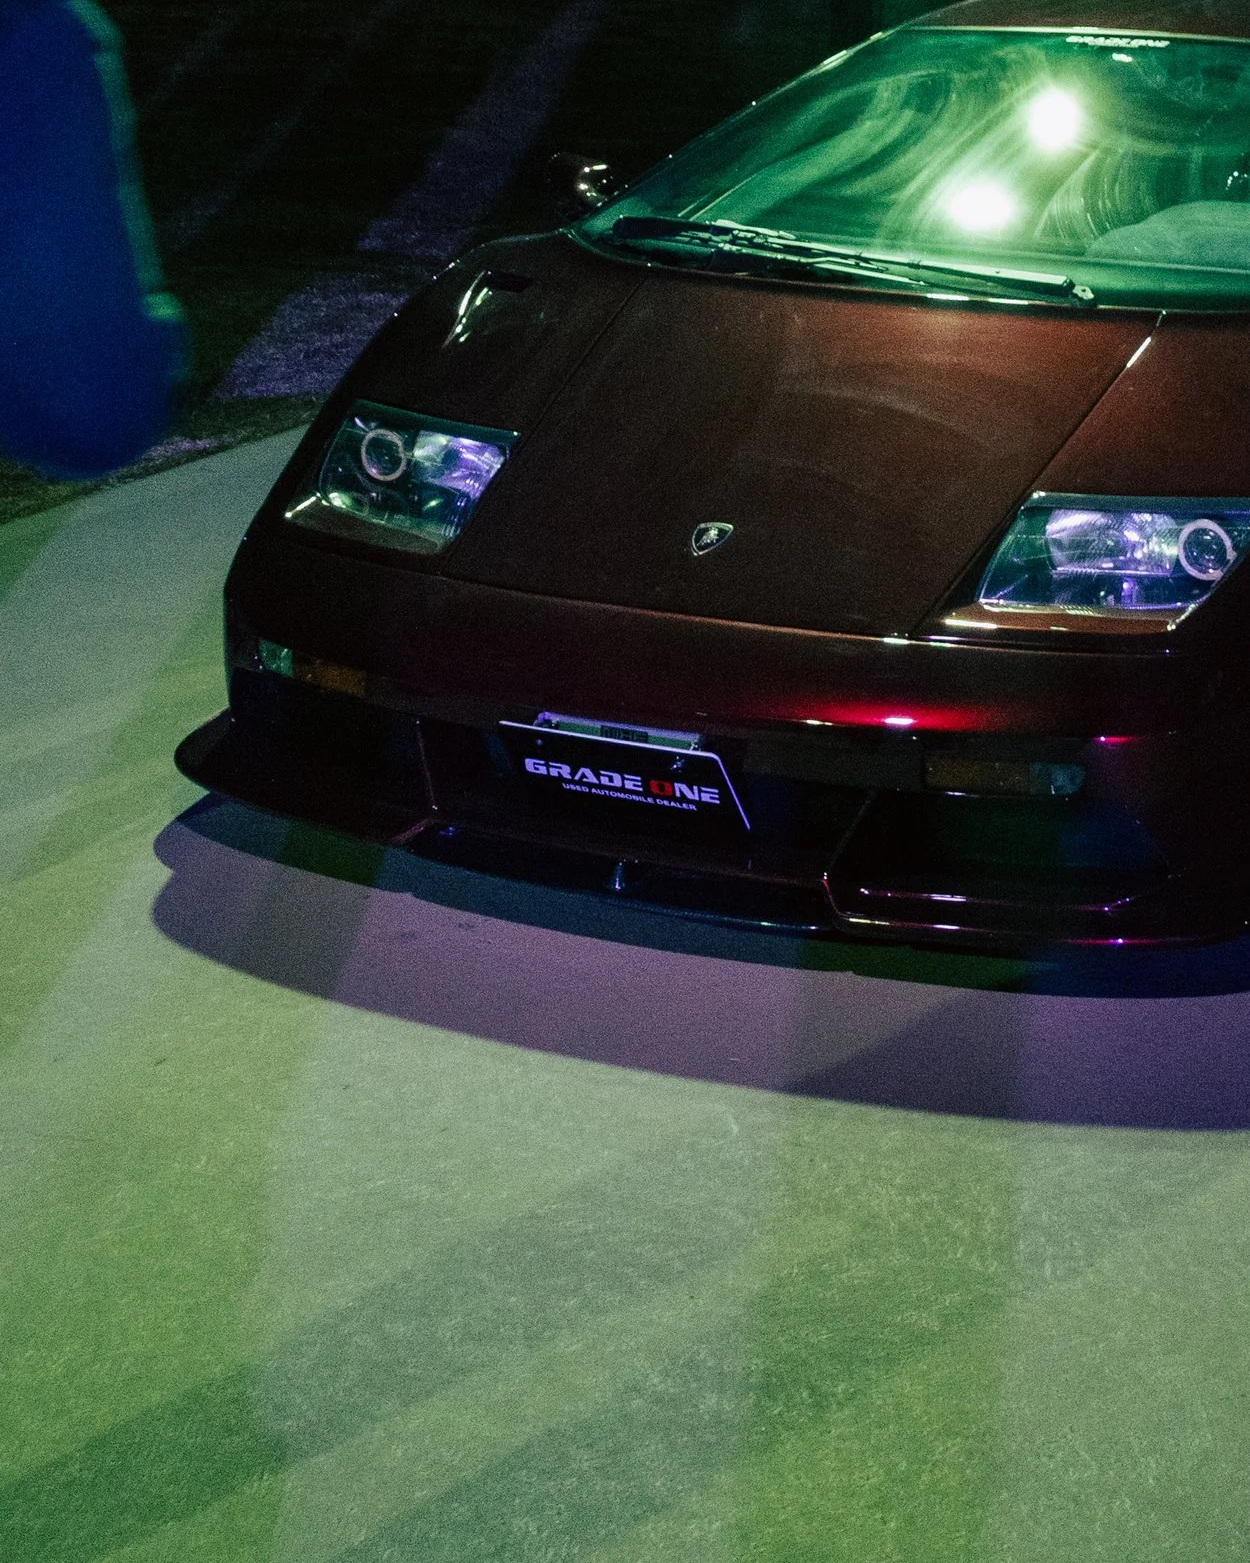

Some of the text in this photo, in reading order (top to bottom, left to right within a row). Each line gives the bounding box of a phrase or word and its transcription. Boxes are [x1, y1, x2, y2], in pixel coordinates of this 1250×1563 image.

[524, 757, 721, 805] GRADE ONE
[561, 782, 698, 812] USED AUTOMOBILE DEALER
